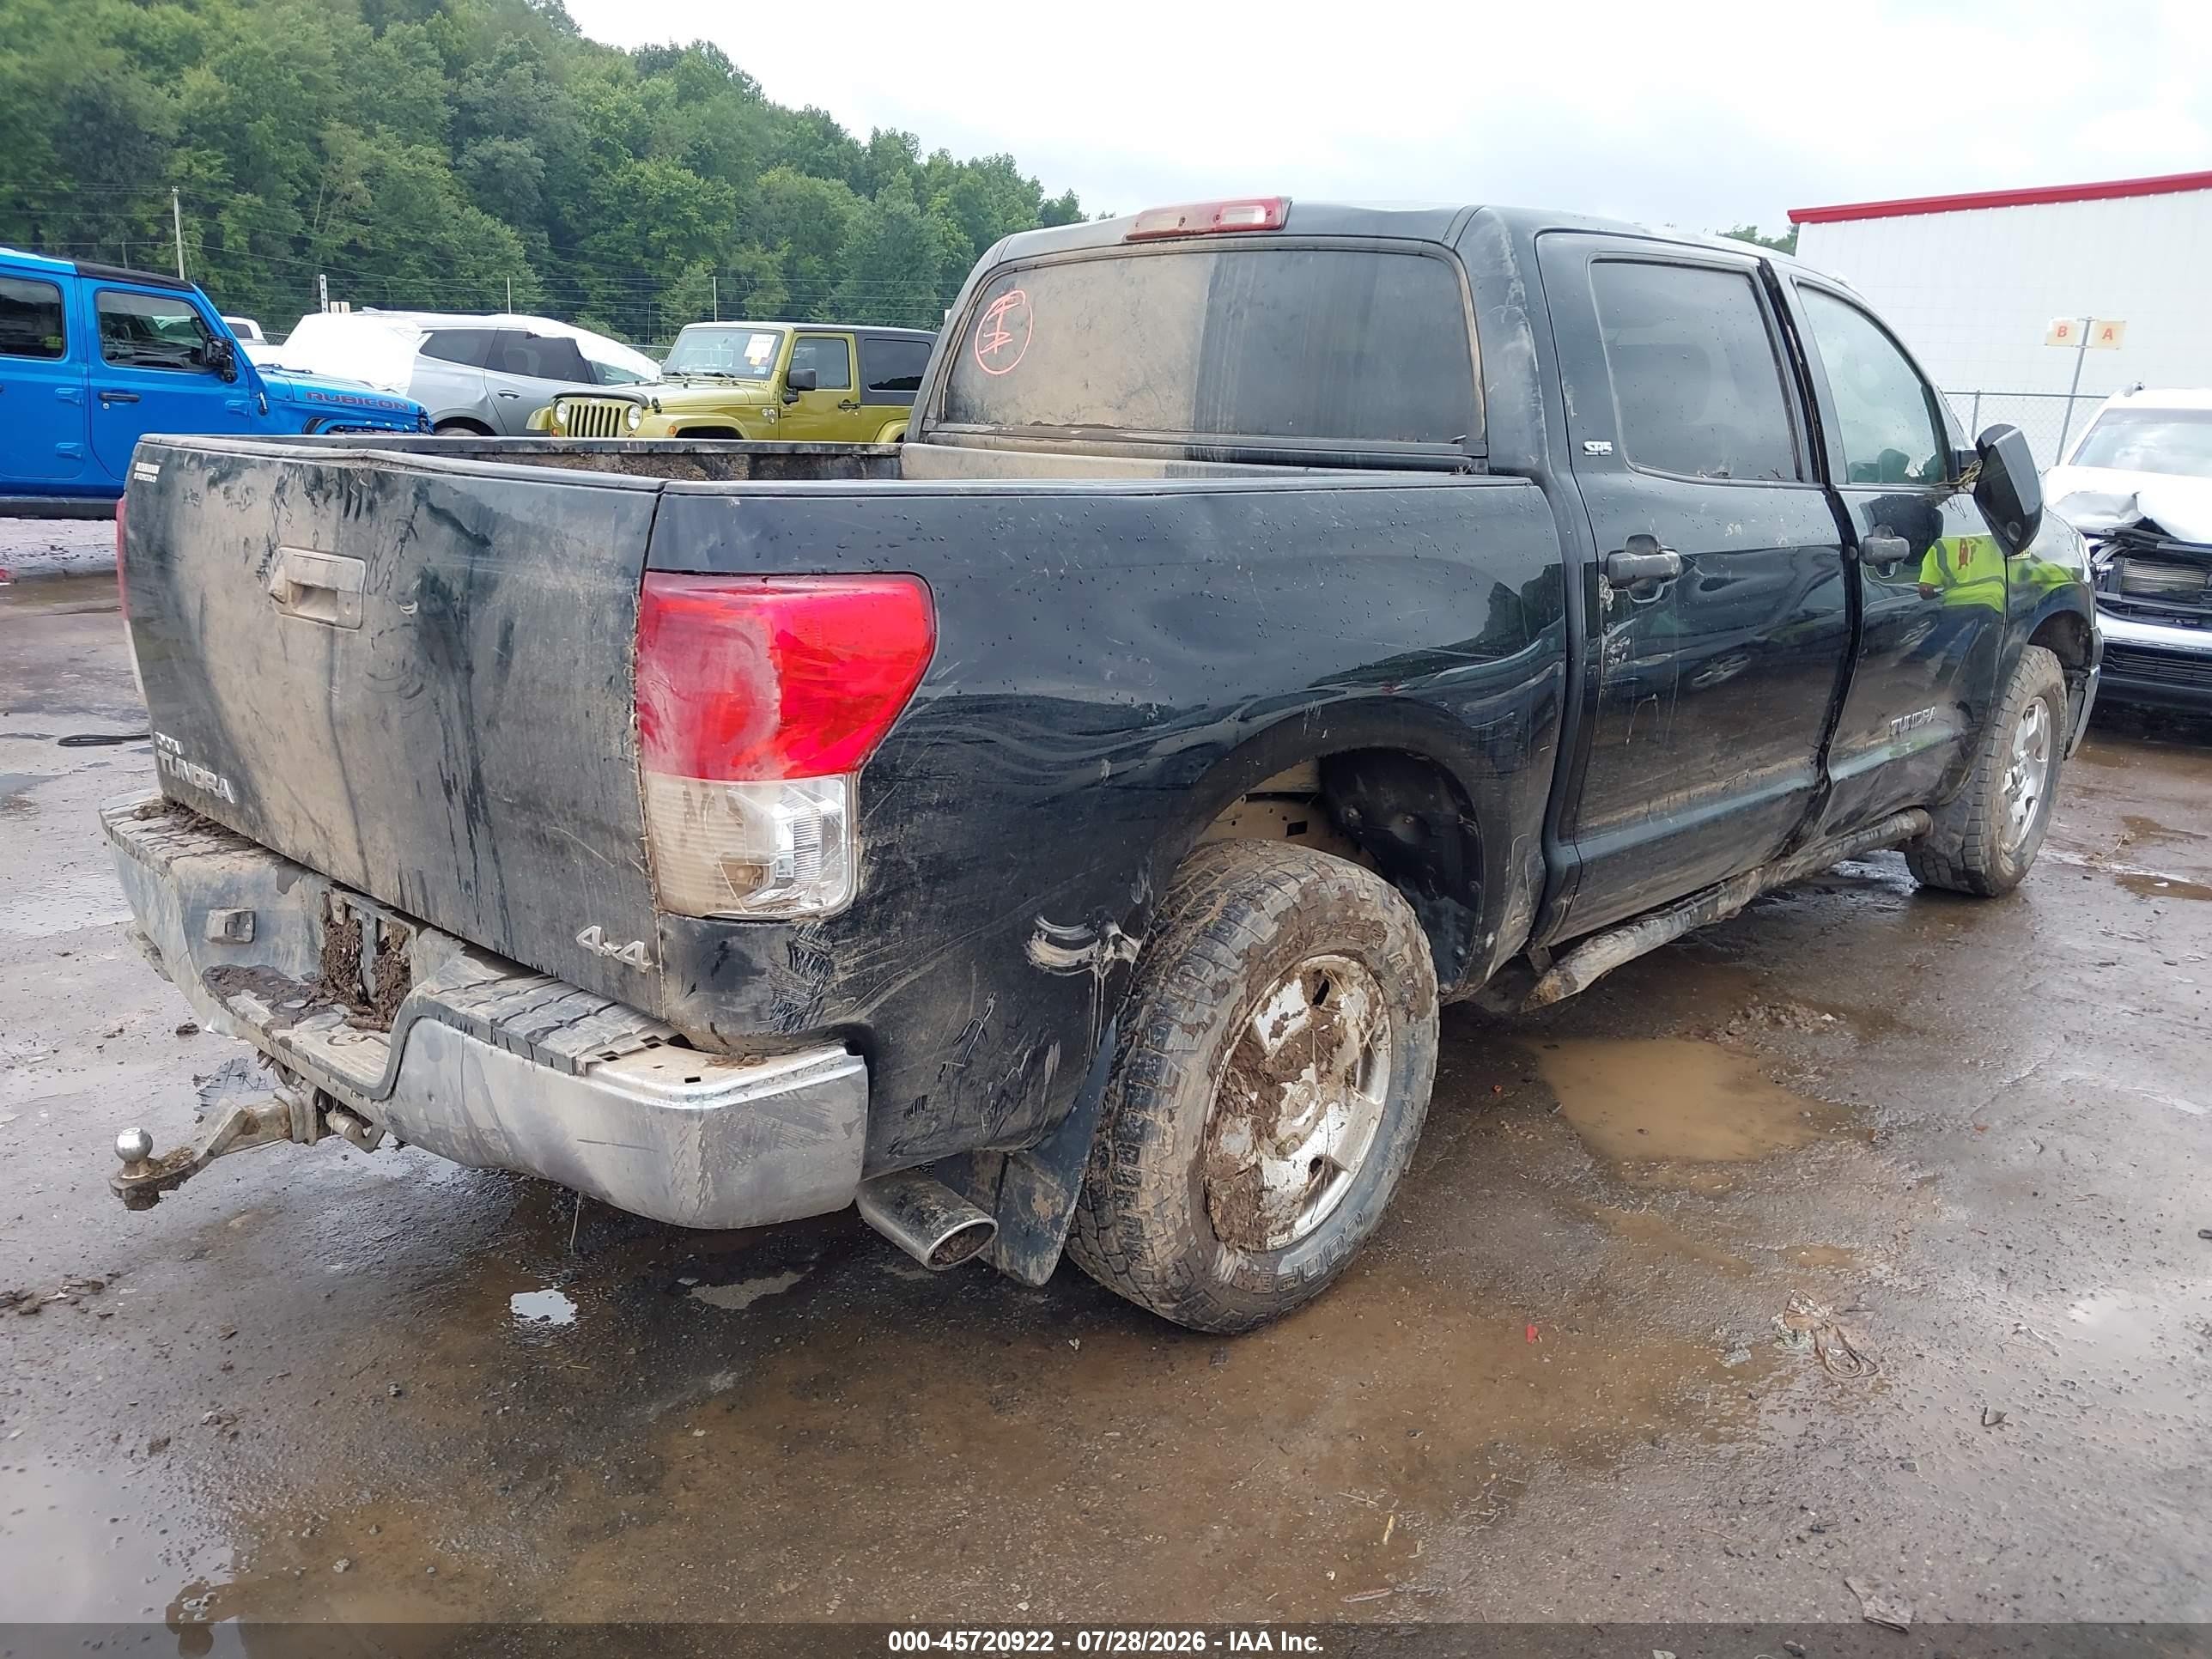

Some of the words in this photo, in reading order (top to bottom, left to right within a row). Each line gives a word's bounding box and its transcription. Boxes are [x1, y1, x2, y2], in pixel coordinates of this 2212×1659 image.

[2057, 325, 2068, 337] B
[2102, 328, 2113, 341] A
[305, 391, 409, 410] RUBICON
[1891, 706, 1937, 736] TUNDRA
[157, 749, 235, 804] TUNDRA
[575, 926, 653, 973] 4x4
